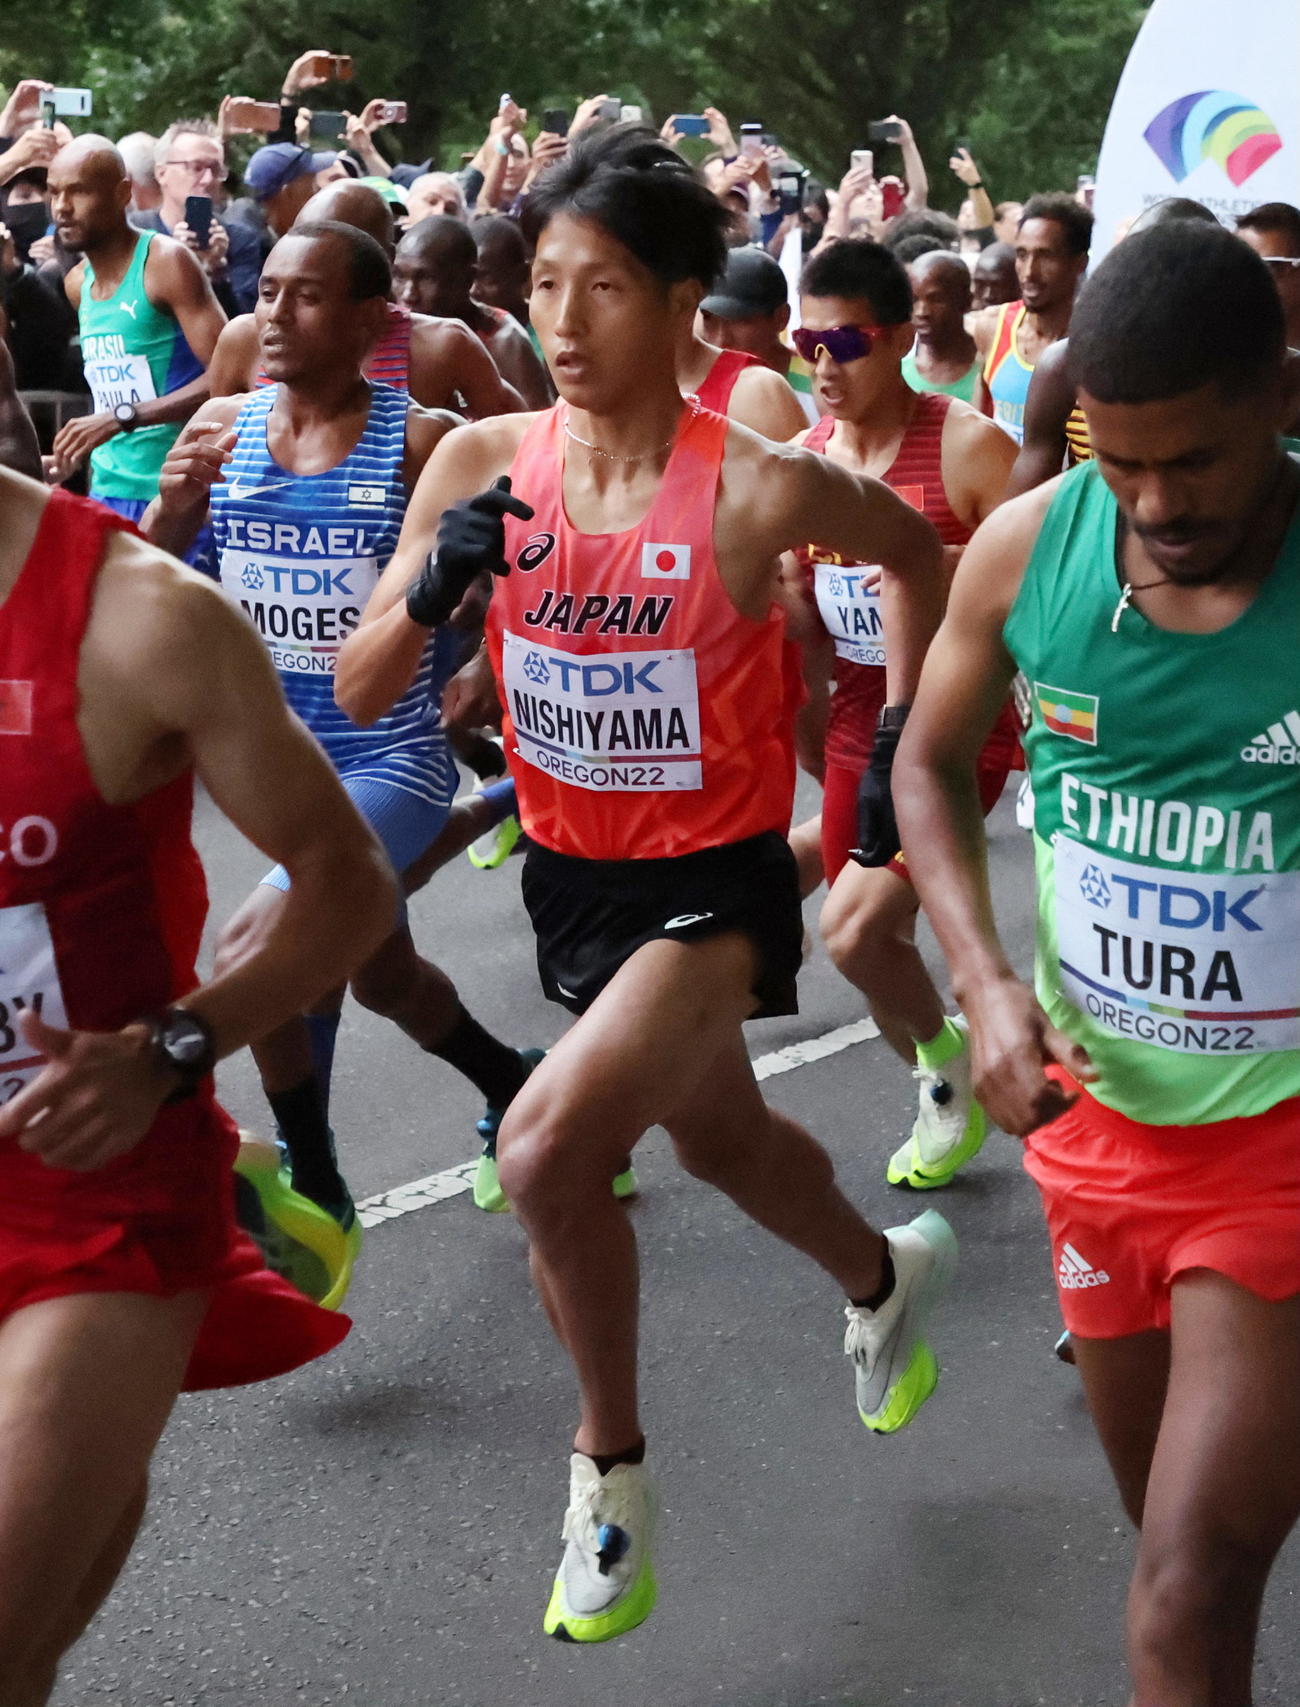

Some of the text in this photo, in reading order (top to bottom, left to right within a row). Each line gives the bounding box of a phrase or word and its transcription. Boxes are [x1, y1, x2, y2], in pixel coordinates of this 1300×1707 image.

[96, 363, 136, 382] TDK
[226, 518, 374, 556] ISRAEL
[263, 565, 354, 595] TDK
[240, 600, 361, 641] MOGES
[523, 590, 674, 636] JAPAN
[548, 656, 664, 697] TDK
[513, 688, 690, 751] NISHIYAMA
[536, 750, 665, 785] OREGON22
[1061, 772, 1274, 870] ETHIOPIA
[1111, 873, 1267, 932] TDK
[1092, 922, 1243, 1003] TURA
[1086, 993, 1255, 1052] OREGON22
[1059, 1270, 1110, 1288] adidas
